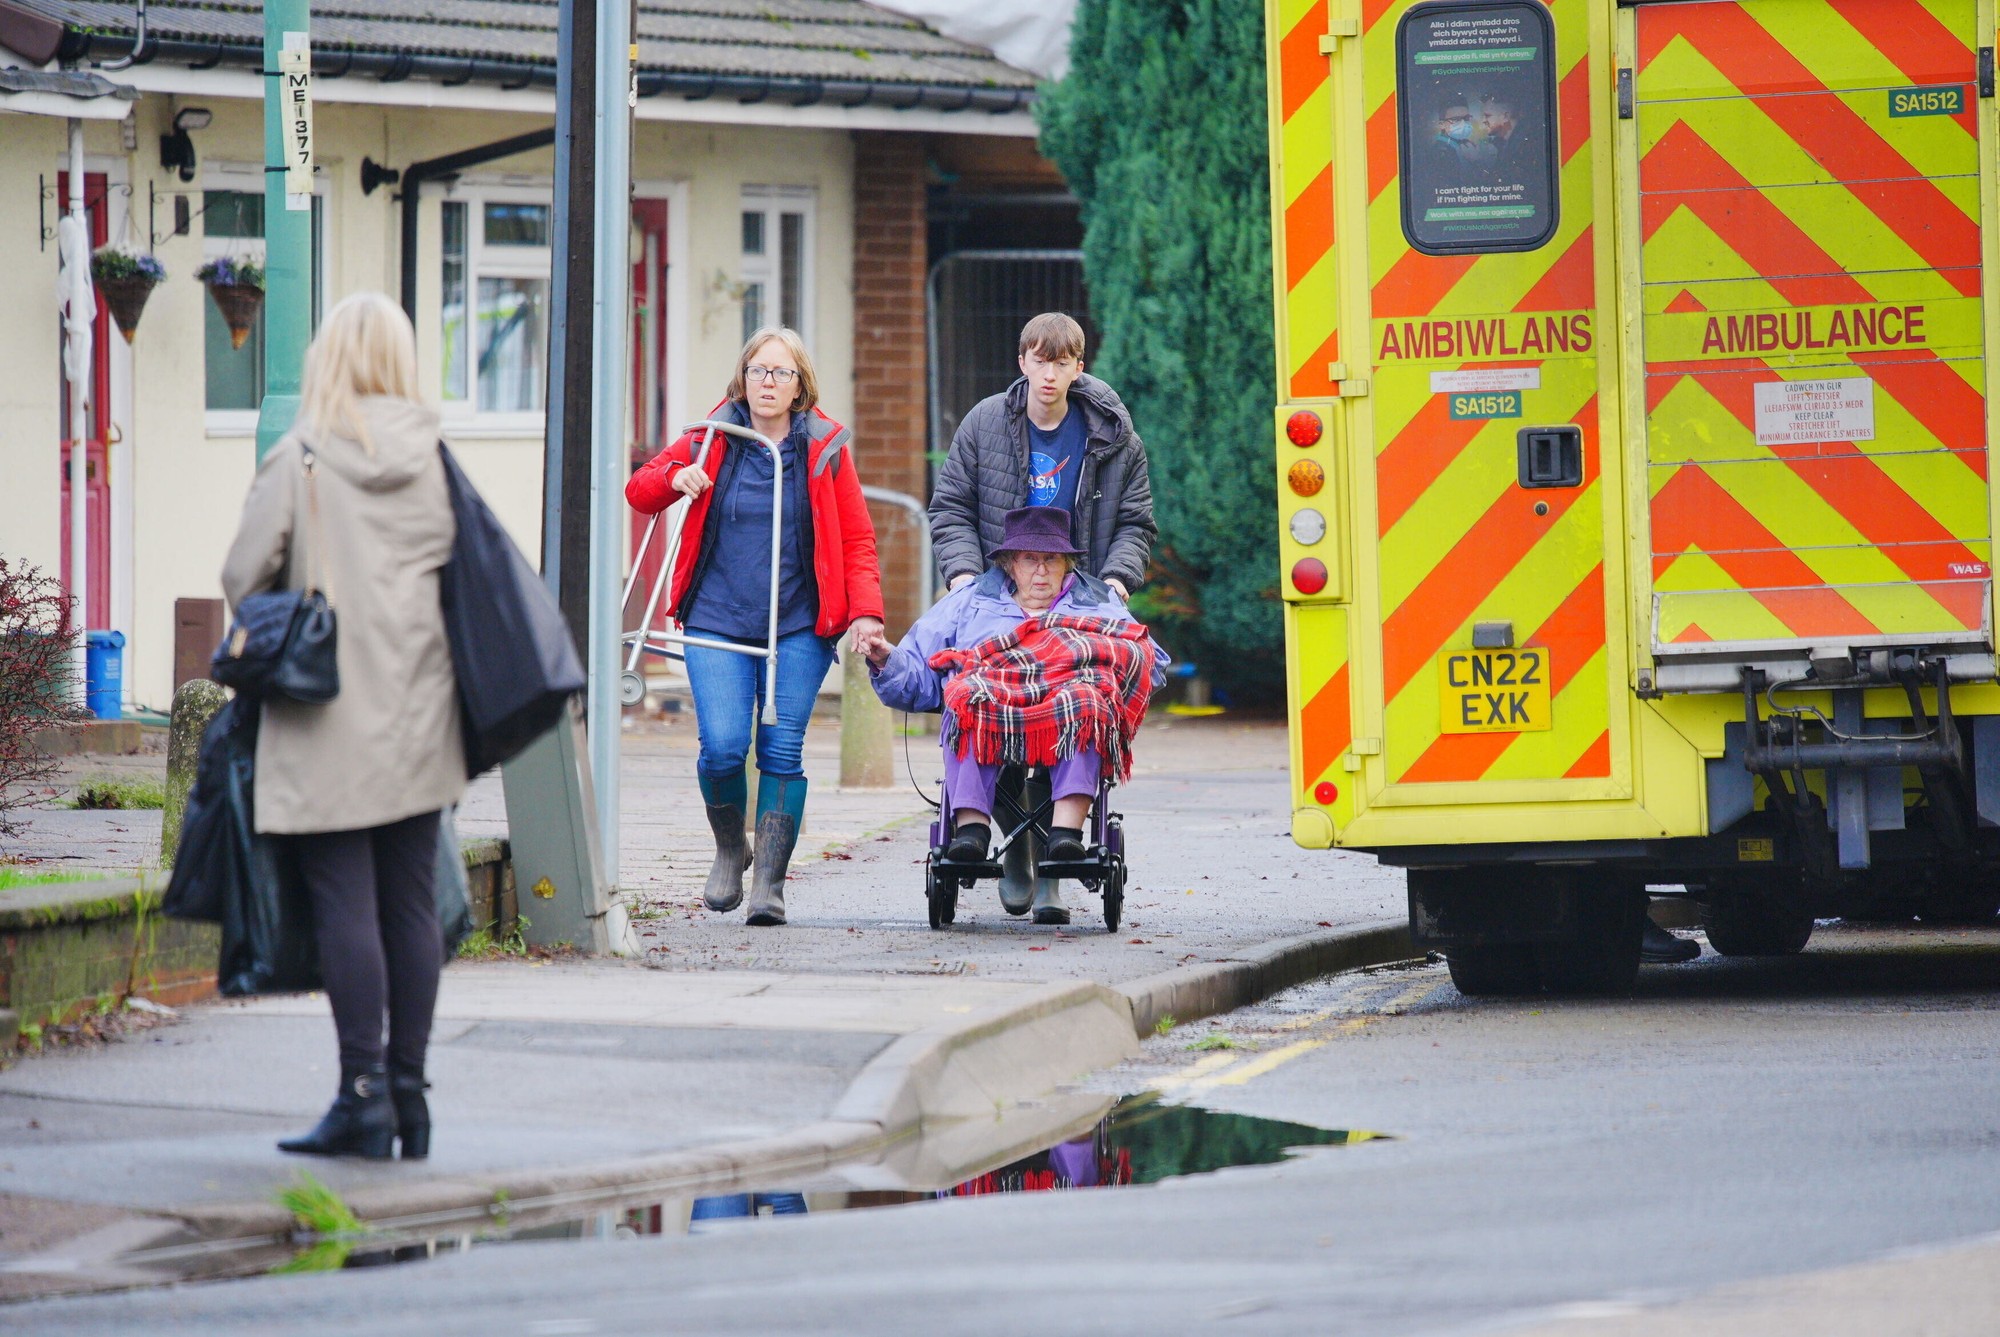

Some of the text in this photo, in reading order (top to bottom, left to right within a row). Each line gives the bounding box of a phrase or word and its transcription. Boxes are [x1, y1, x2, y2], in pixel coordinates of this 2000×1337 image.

[1472, 19, 1500, 28] ymladd
[1452, 29, 1478, 38] bywyd
[1490, 27, 1507, 36] ydw
[1429, 38, 1458, 47] ymladd
[1478, 36, 1487, 45] fy
[1488, 35, 1516, 44] mywyd
[1895, 92, 1958, 112] SA1512
[1461, 186, 1479, 195] fight
[1457, 194, 1488, 203] fighting
[1702, 306, 1926, 354] AMBULANCE
[1379, 314, 1592, 360] AMBIWLANS
[1785, 384, 1813, 392] CADWCH
[1827, 382, 1842, 390] GLIR
[1788, 392, 1840, 402] LIFFT STRETSIER
[1455, 396, 1516, 415] SA1512
[1764, 400, 1864, 413] LLEIAFSWM CLIRIAD 3.5 MEDR
[1795, 411, 1834, 421] KEEP CLEAR
[1789, 421, 1840, 430] STRETCHER LIFT
[1760, 429, 1871, 442] MINIMUM CLEARANCE 3.5 METRES
[1028, 475, 1056, 488] ASA
[1953, 564, 1982, 574] WAS
[1448, 652, 1540, 687] CN22
[1462, 692, 1530, 726] EXK
